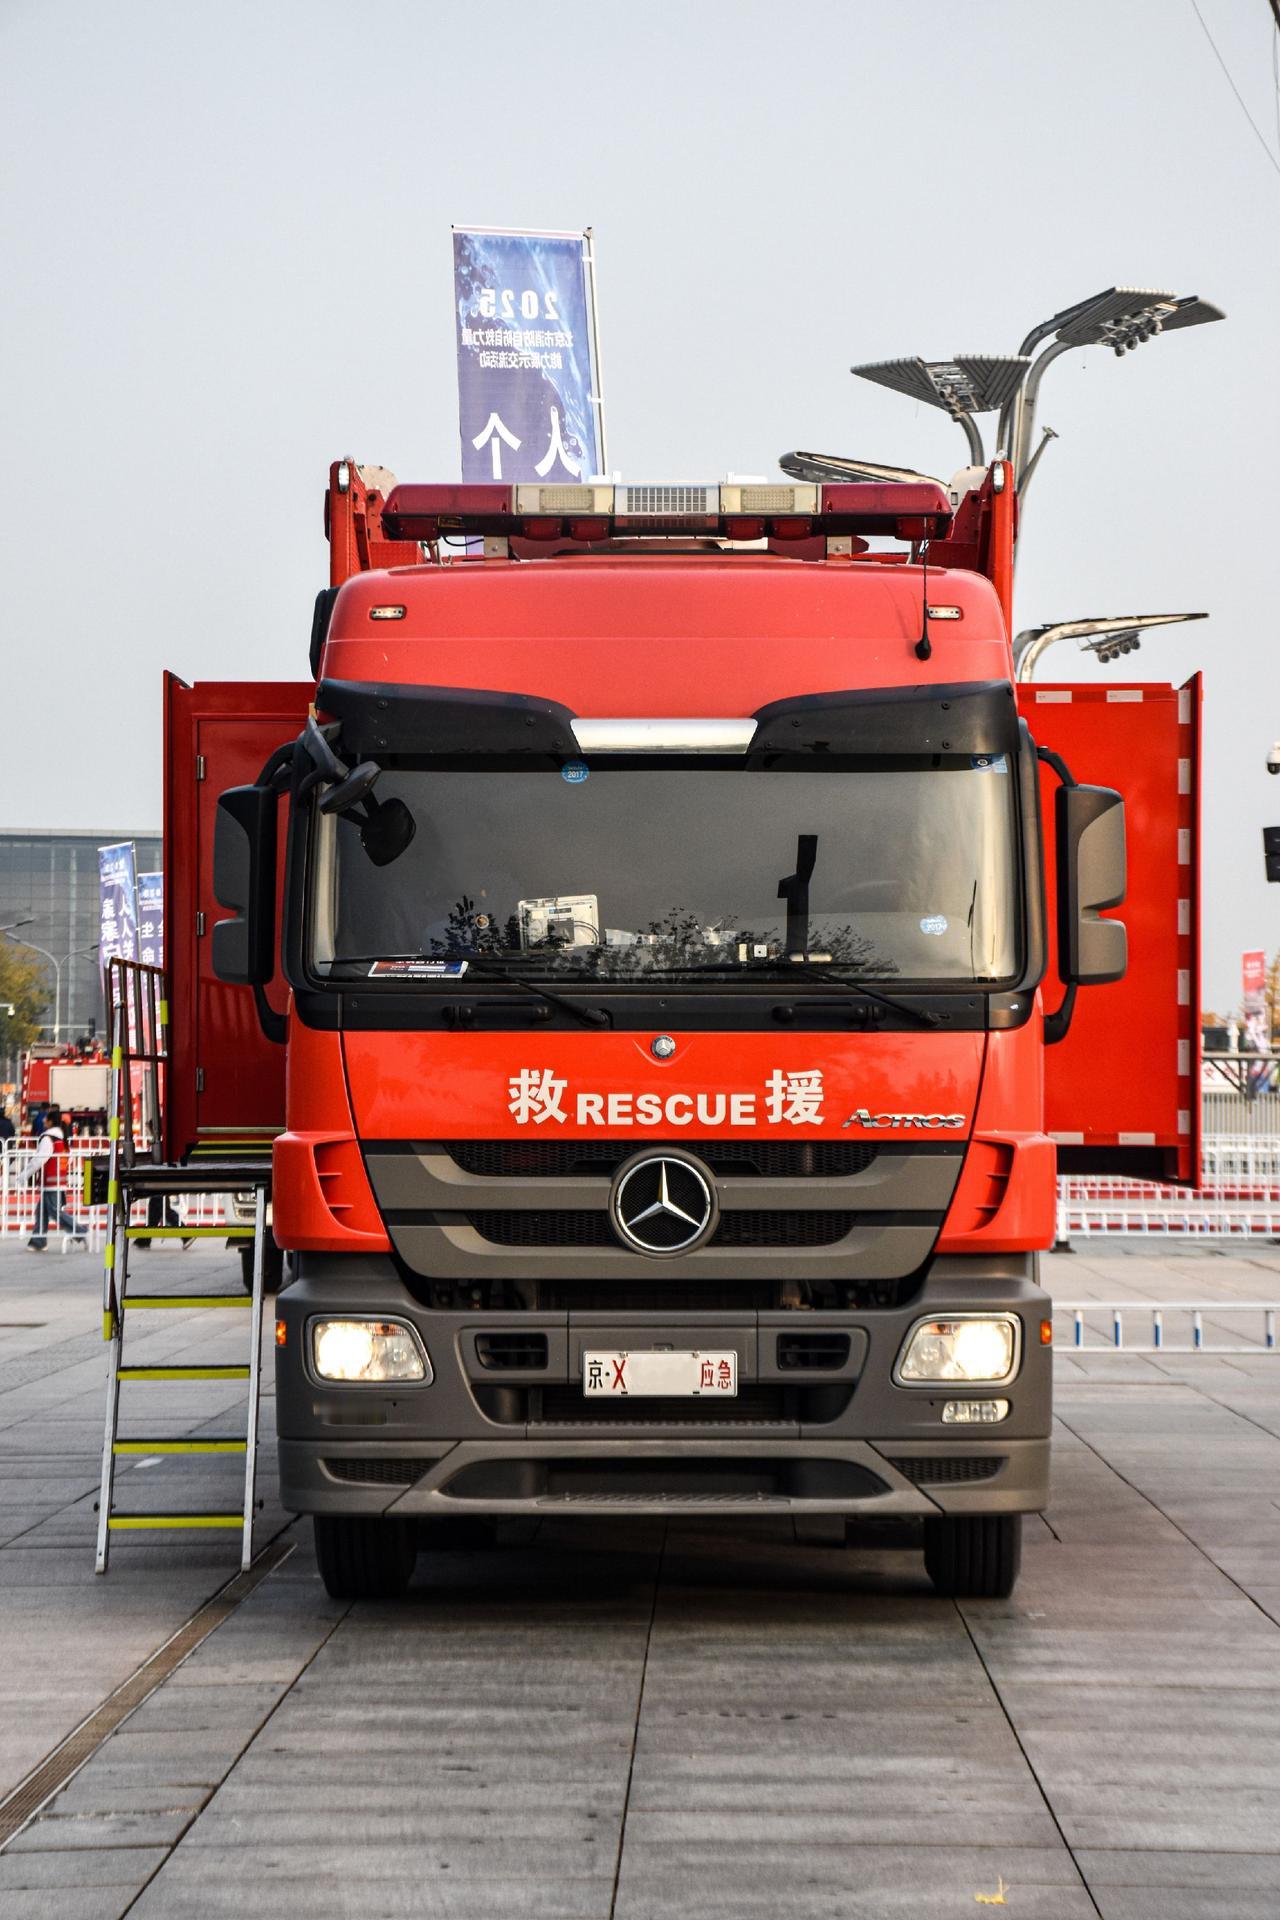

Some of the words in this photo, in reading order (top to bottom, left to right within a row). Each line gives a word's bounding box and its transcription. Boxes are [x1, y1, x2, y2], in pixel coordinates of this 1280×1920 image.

[567, 770, 584, 778] 2017
[508, 1068, 567, 1125] 救
[576, 1093, 757, 1125] RESCUE
[765, 1069, 825, 1125] 援
[700, 1360, 732, 1389] 应急
